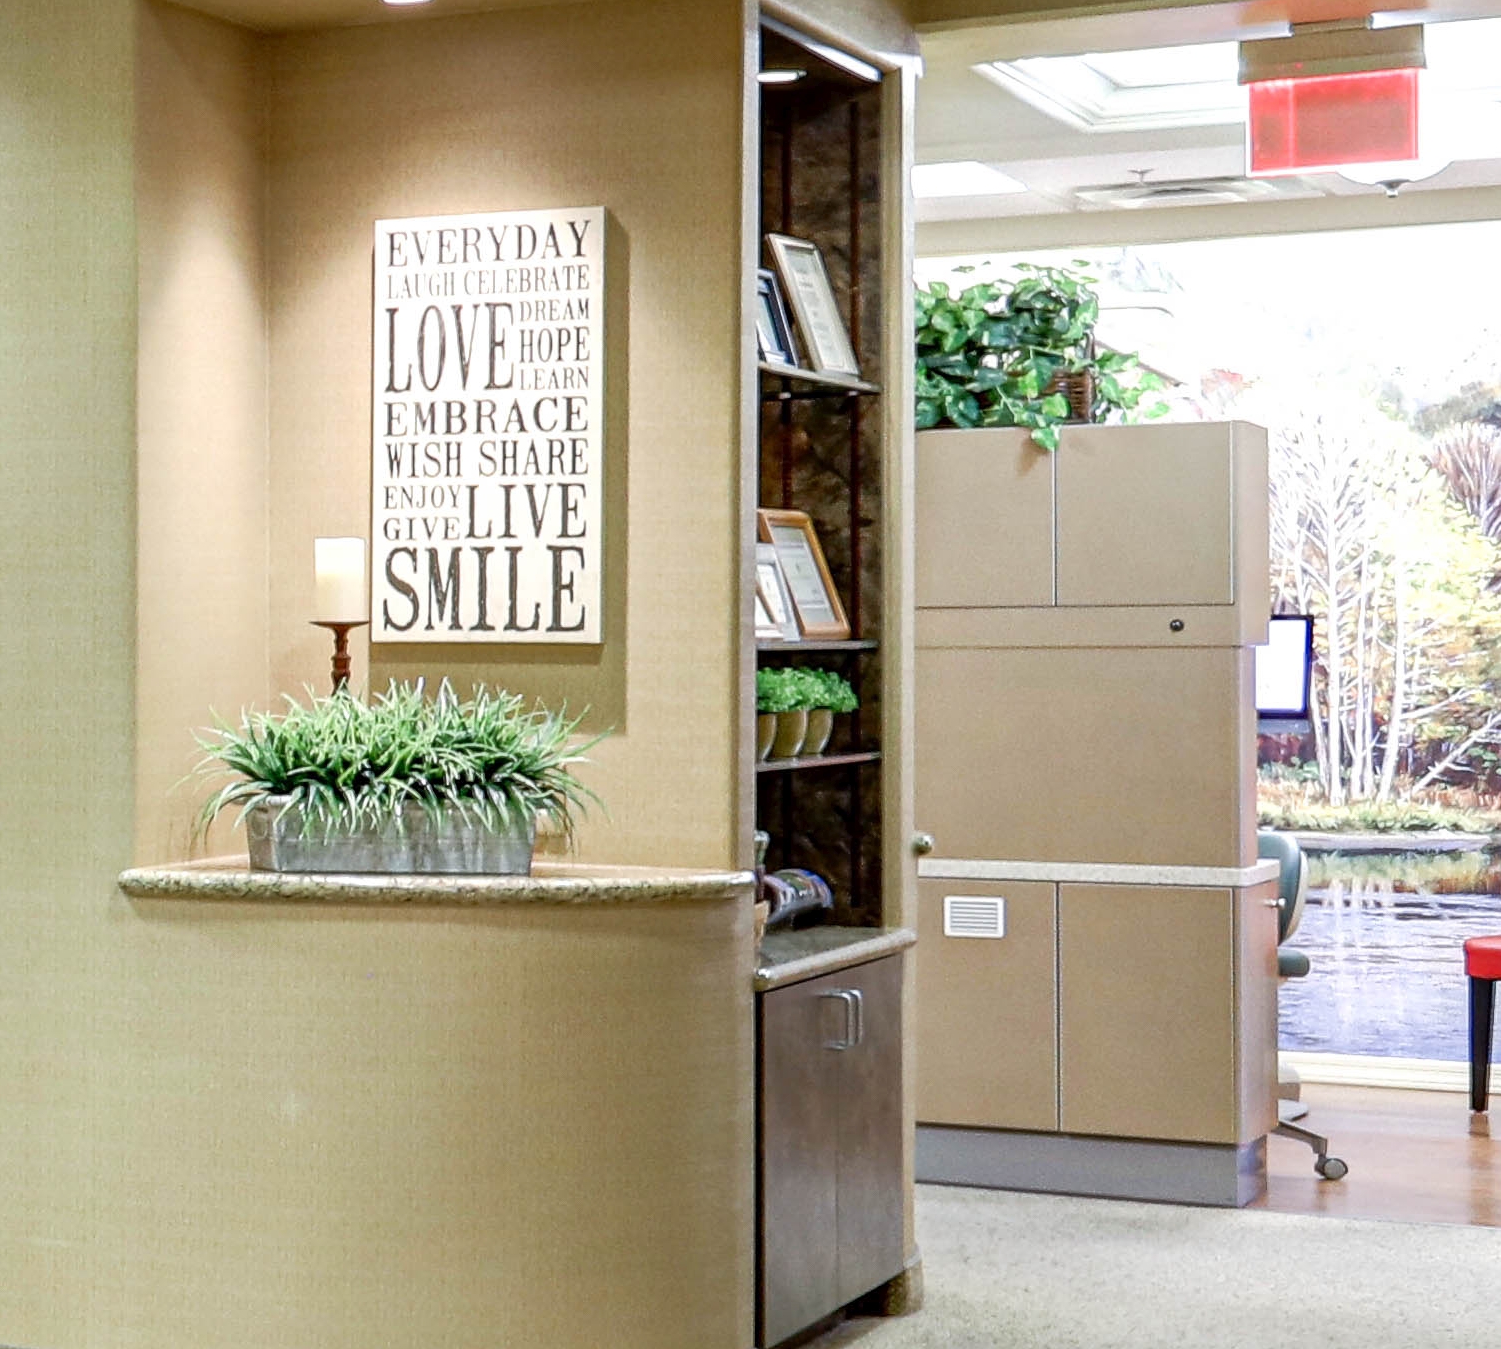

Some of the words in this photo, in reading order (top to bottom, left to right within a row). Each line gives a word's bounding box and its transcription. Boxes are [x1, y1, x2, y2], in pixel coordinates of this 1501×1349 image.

[385, 219, 592, 268] EVERYDAY
[386, 270, 457, 300] LAUGH
[463, 264, 590, 297] CELEBRATE
[519, 297, 590, 323] DREAM
[384, 302, 514, 394] LOVE
[518, 326, 591, 364] HOPE
[519, 365, 590, 391] LEARN
[383, 395, 589, 438] EMBRACE
[385, 441, 463, 479] WISH
[478, 438, 589, 478] SHARE
[383, 484, 463, 511] ENJOY
[465, 483, 587, 540] LIVE
[383, 516, 461, 542] GIVE
[383, 545, 585, 633] SMILE
